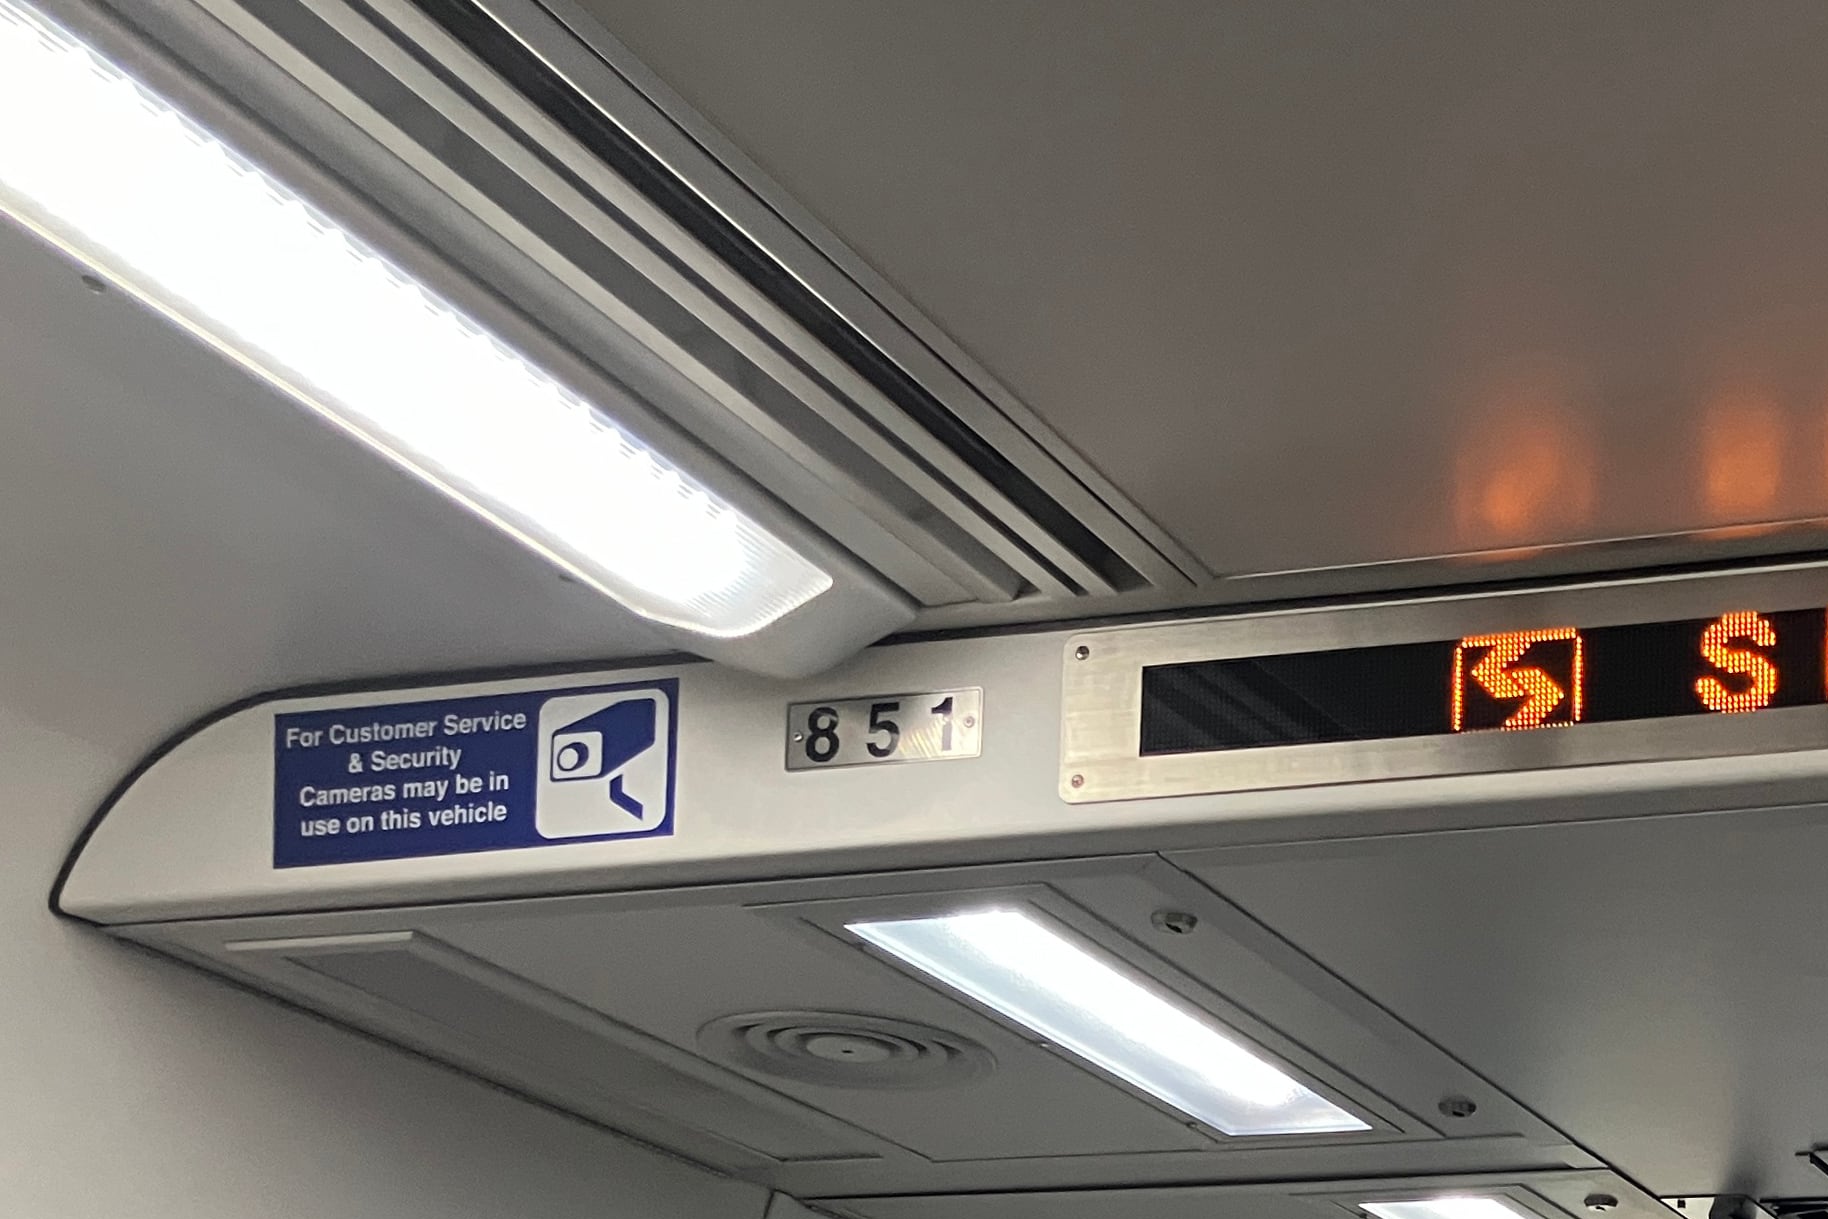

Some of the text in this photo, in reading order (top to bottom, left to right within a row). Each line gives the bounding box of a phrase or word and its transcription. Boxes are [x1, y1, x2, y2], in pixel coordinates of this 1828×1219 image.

[287, 711, 526, 748] For Customer Service
[348, 746, 462, 773] & Security
[300, 771, 509, 806] Cameras may be in
[301, 801, 508, 836] use on this vehicle
